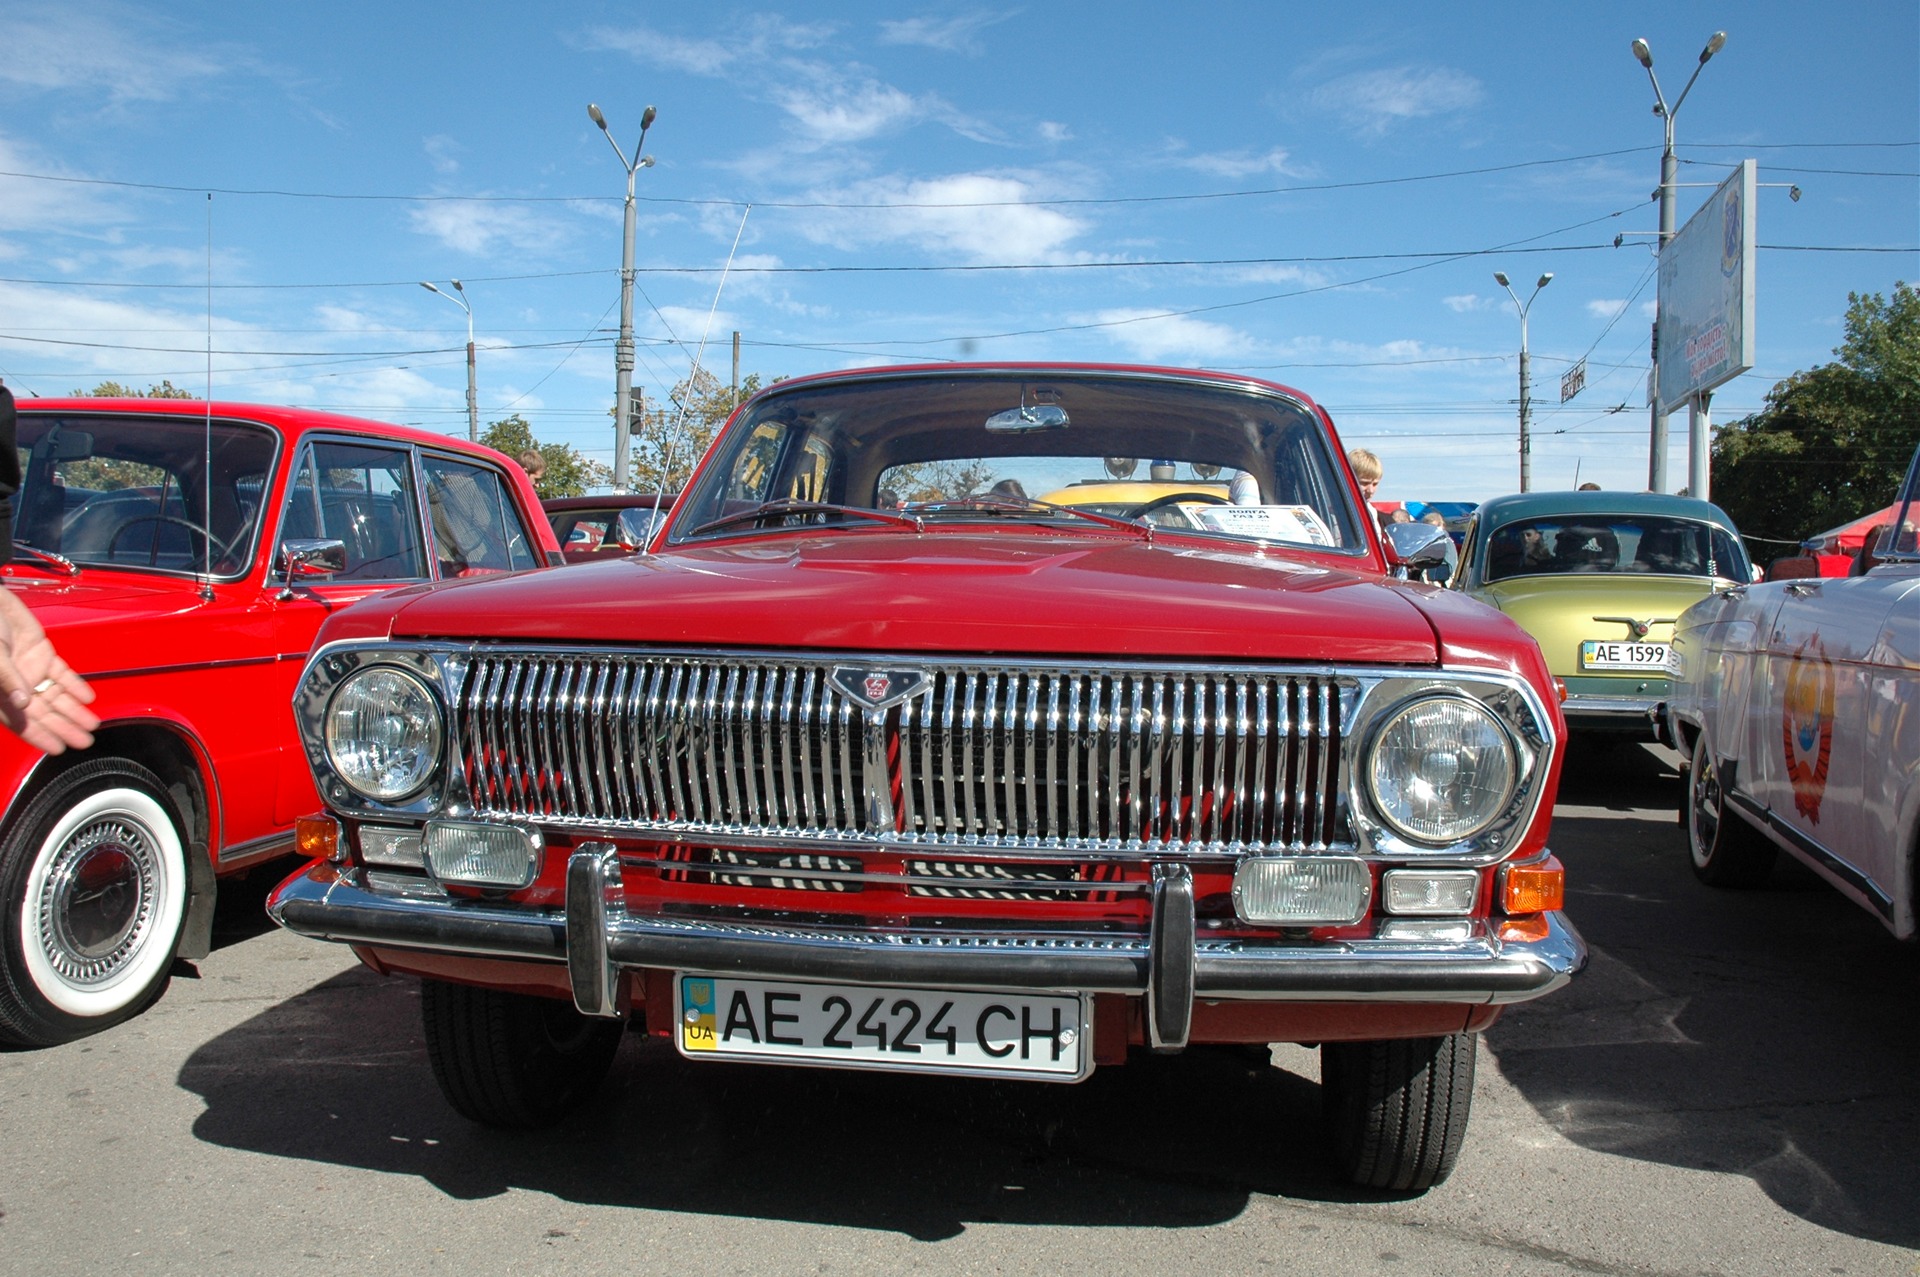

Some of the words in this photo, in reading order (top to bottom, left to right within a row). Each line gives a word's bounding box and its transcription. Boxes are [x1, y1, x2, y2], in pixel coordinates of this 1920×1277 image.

[1596, 645, 1620, 661] AE
[1626, 646, 1664, 662] 1599
[690, 1026, 713, 1040] UA
[722, 990, 803, 1046] AE
[821, 996, 957, 1055] 2424
[976, 1005, 1061, 1061] CH
